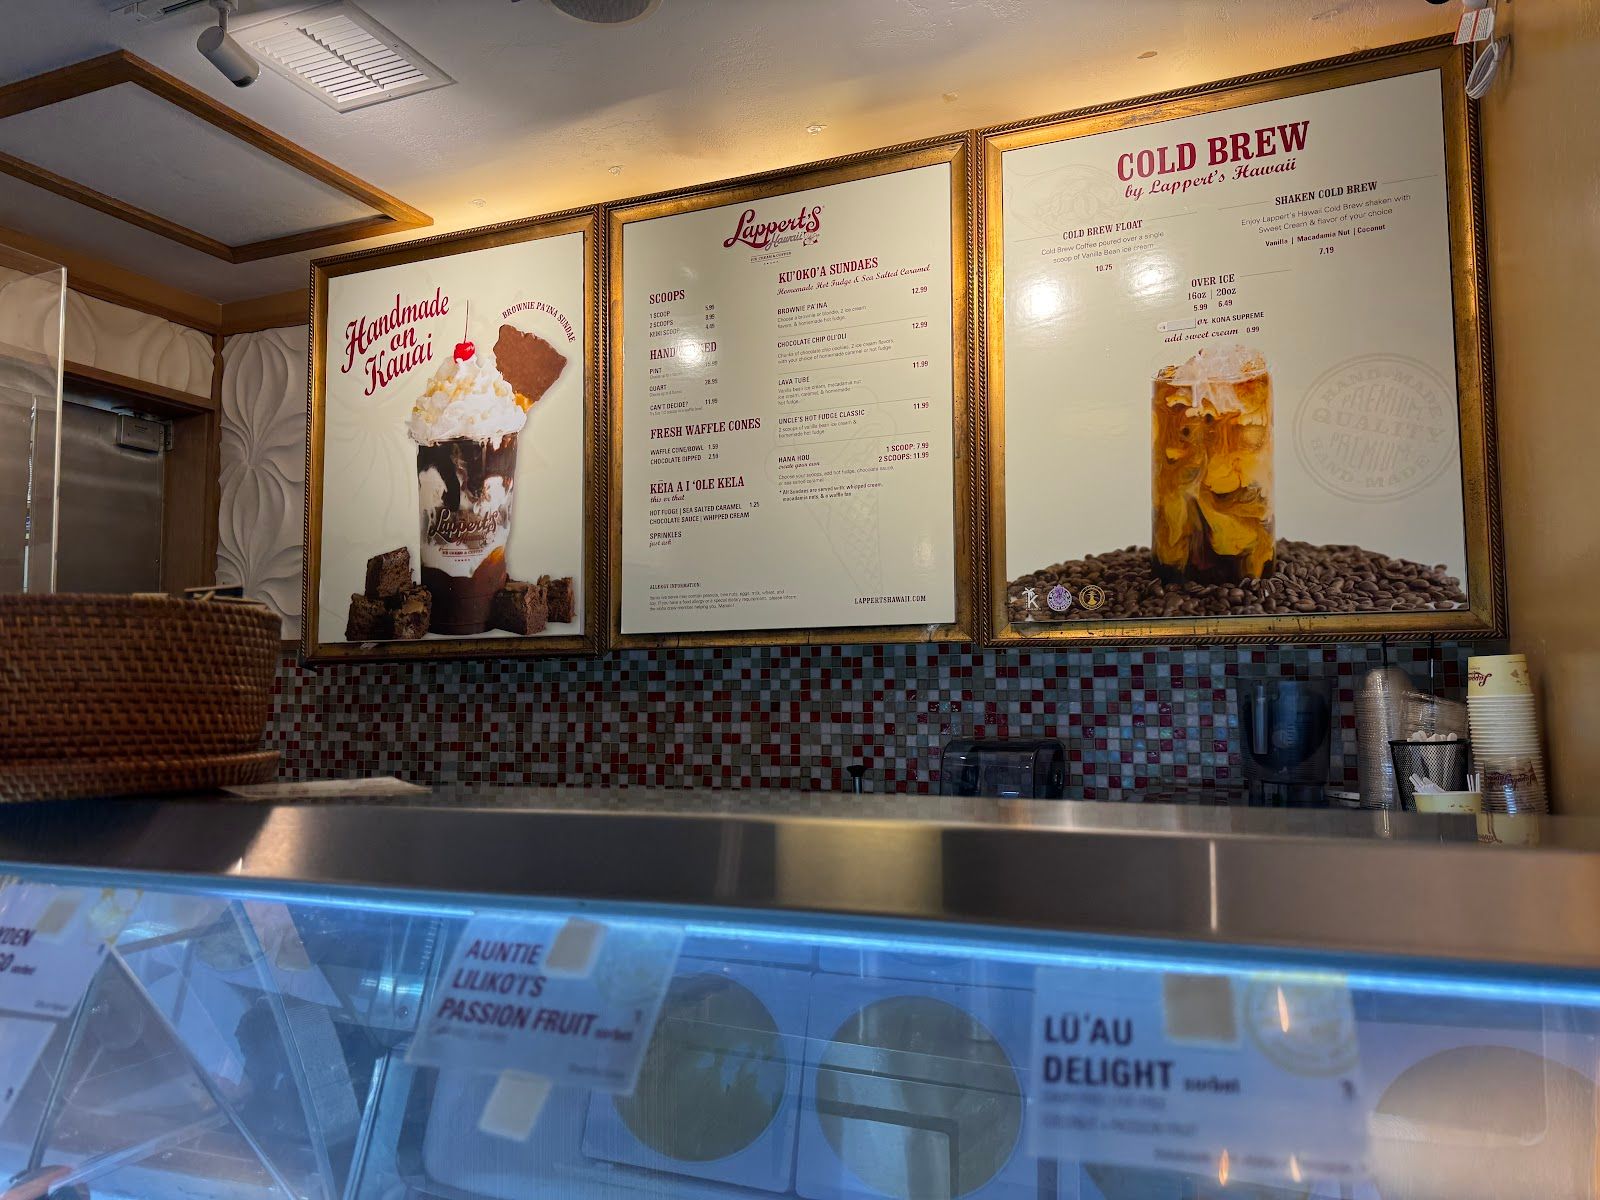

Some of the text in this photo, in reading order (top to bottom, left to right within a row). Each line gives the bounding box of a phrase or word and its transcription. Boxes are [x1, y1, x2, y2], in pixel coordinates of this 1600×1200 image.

[1117, 120, 1311, 182] COLD BREW
[1125, 157, 1297, 201] by Lappert's Hawaii
[1275, 180, 1378, 206] SHAKEN COLD BREW
[1241, 192, 1412, 227] Enjoy Lappert's Hawaii Cold Brew shaken with
[1258, 207, 1393, 234] Sweet Cream & flavor of your choice
[1062, 219, 1143, 241] COLD BREW FLOAT
[1265, 223, 1386, 247] Vanilla Macadamia Nut Coconut
[764, 231, 803, 251] Hawaii
[1041, 247, 1056, 256] Cold
[1057, 245, 1075, 254] Brew
[1075, 242, 1097, 250] Coffee
[1098, 238, 1121, 248] poured
[1122, 235, 1138, 243] over
[1144, 231, 1165, 241] single
[1053, 256, 1072, 264] scoop
[1081, 250, 1103, 260] Vanilla
[1103, 248, 1121, 256] Bean
[1121, 245, 1132, 253] ice
[1133, 243, 1154, 251] cream
[1319, 246, 1335, 256] 7.19
[829, 256, 879, 276] SUNDAES
[1095, 263, 1113, 272] 10.75
[776, 263, 931, 296] Homemade Hot Fudge & Sea Salted Caramel
[1191, 273, 1235, 288] OVER ICE
[649, 289, 685, 305] SCOOPS
[911, 286, 928, 295] 12.99
[1187, 287, 1237, 301] 16oz 20oz
[777, 305, 805, 315] BROWNIE
[1193, 303, 1208, 312] 5.99
[501, 301, 536, 319] BROWNIE
[557, 313, 576, 343] SUNDAE
[653, 311, 671, 319] SCOOP
[1211, 315, 1231, 324] KONA
[1232, 311, 1265, 321] SUPREME
[341, 286, 449, 374] Handmade
[653, 320, 674, 328] SCOOPS
[911, 321, 928, 330] 12.99
[1246, 326, 1260, 334] 0.99
[390, 326, 418, 352] on
[777, 338, 811, 348] CHOCOLATE
[811, 335, 826, 344] CHIP
[1164, 328, 1239, 343] add sweet cream
[650, 347, 676, 360] HAND
[364, 333, 434, 397] Kauai
[649, 367, 662, 375] PINT
[912, 360, 929, 369] 11.99
[649, 384, 667, 392] QUART
[777, 376, 811, 386] LAVA TUBE
[649, 403, 666, 411] CAN'T
[666, 401, 689, 409] DECIDE?
[913, 402, 929, 411] 11.99
[778, 409, 865, 425] UNCLE'S HOT FUDGE CLASSIC
[650, 417, 761, 440] FRESH WAFFLE CONES
[1311, 407, 1445, 443] QUALITY
[650, 447, 671, 456] WAFFLE
[891, 443, 916, 452] SCOOP:
[650, 454, 702, 465] CHOCOLATE DIPPED
[778, 455, 796, 463] HANA
[883, 453, 912, 462] SCOOPS:
[913, 451, 929, 459] 11.99
[676, 481, 684, 492] A
[685, 480, 690, 492] I
[717, 475, 745, 489] KELA
[650, 495, 662, 503] this
[671, 494, 685, 502] that
[649, 503, 742, 516] HOT FUDGE SEA SALTED CARAMEL
[649, 511, 750, 525] CHOCOLATE SAUCE WHIPPED CREAM
[649, 531, 682, 540] SPRINKLES
[854, 595, 927, 605] LAPPERTSHAWAII.COM
[465, 939, 544, 966] AUNTIE
[437, 998, 533, 1031] PASSION
[532, 1009, 600, 1038] FRUIT
[1042, 1055, 1175, 1092] DELIGHT
